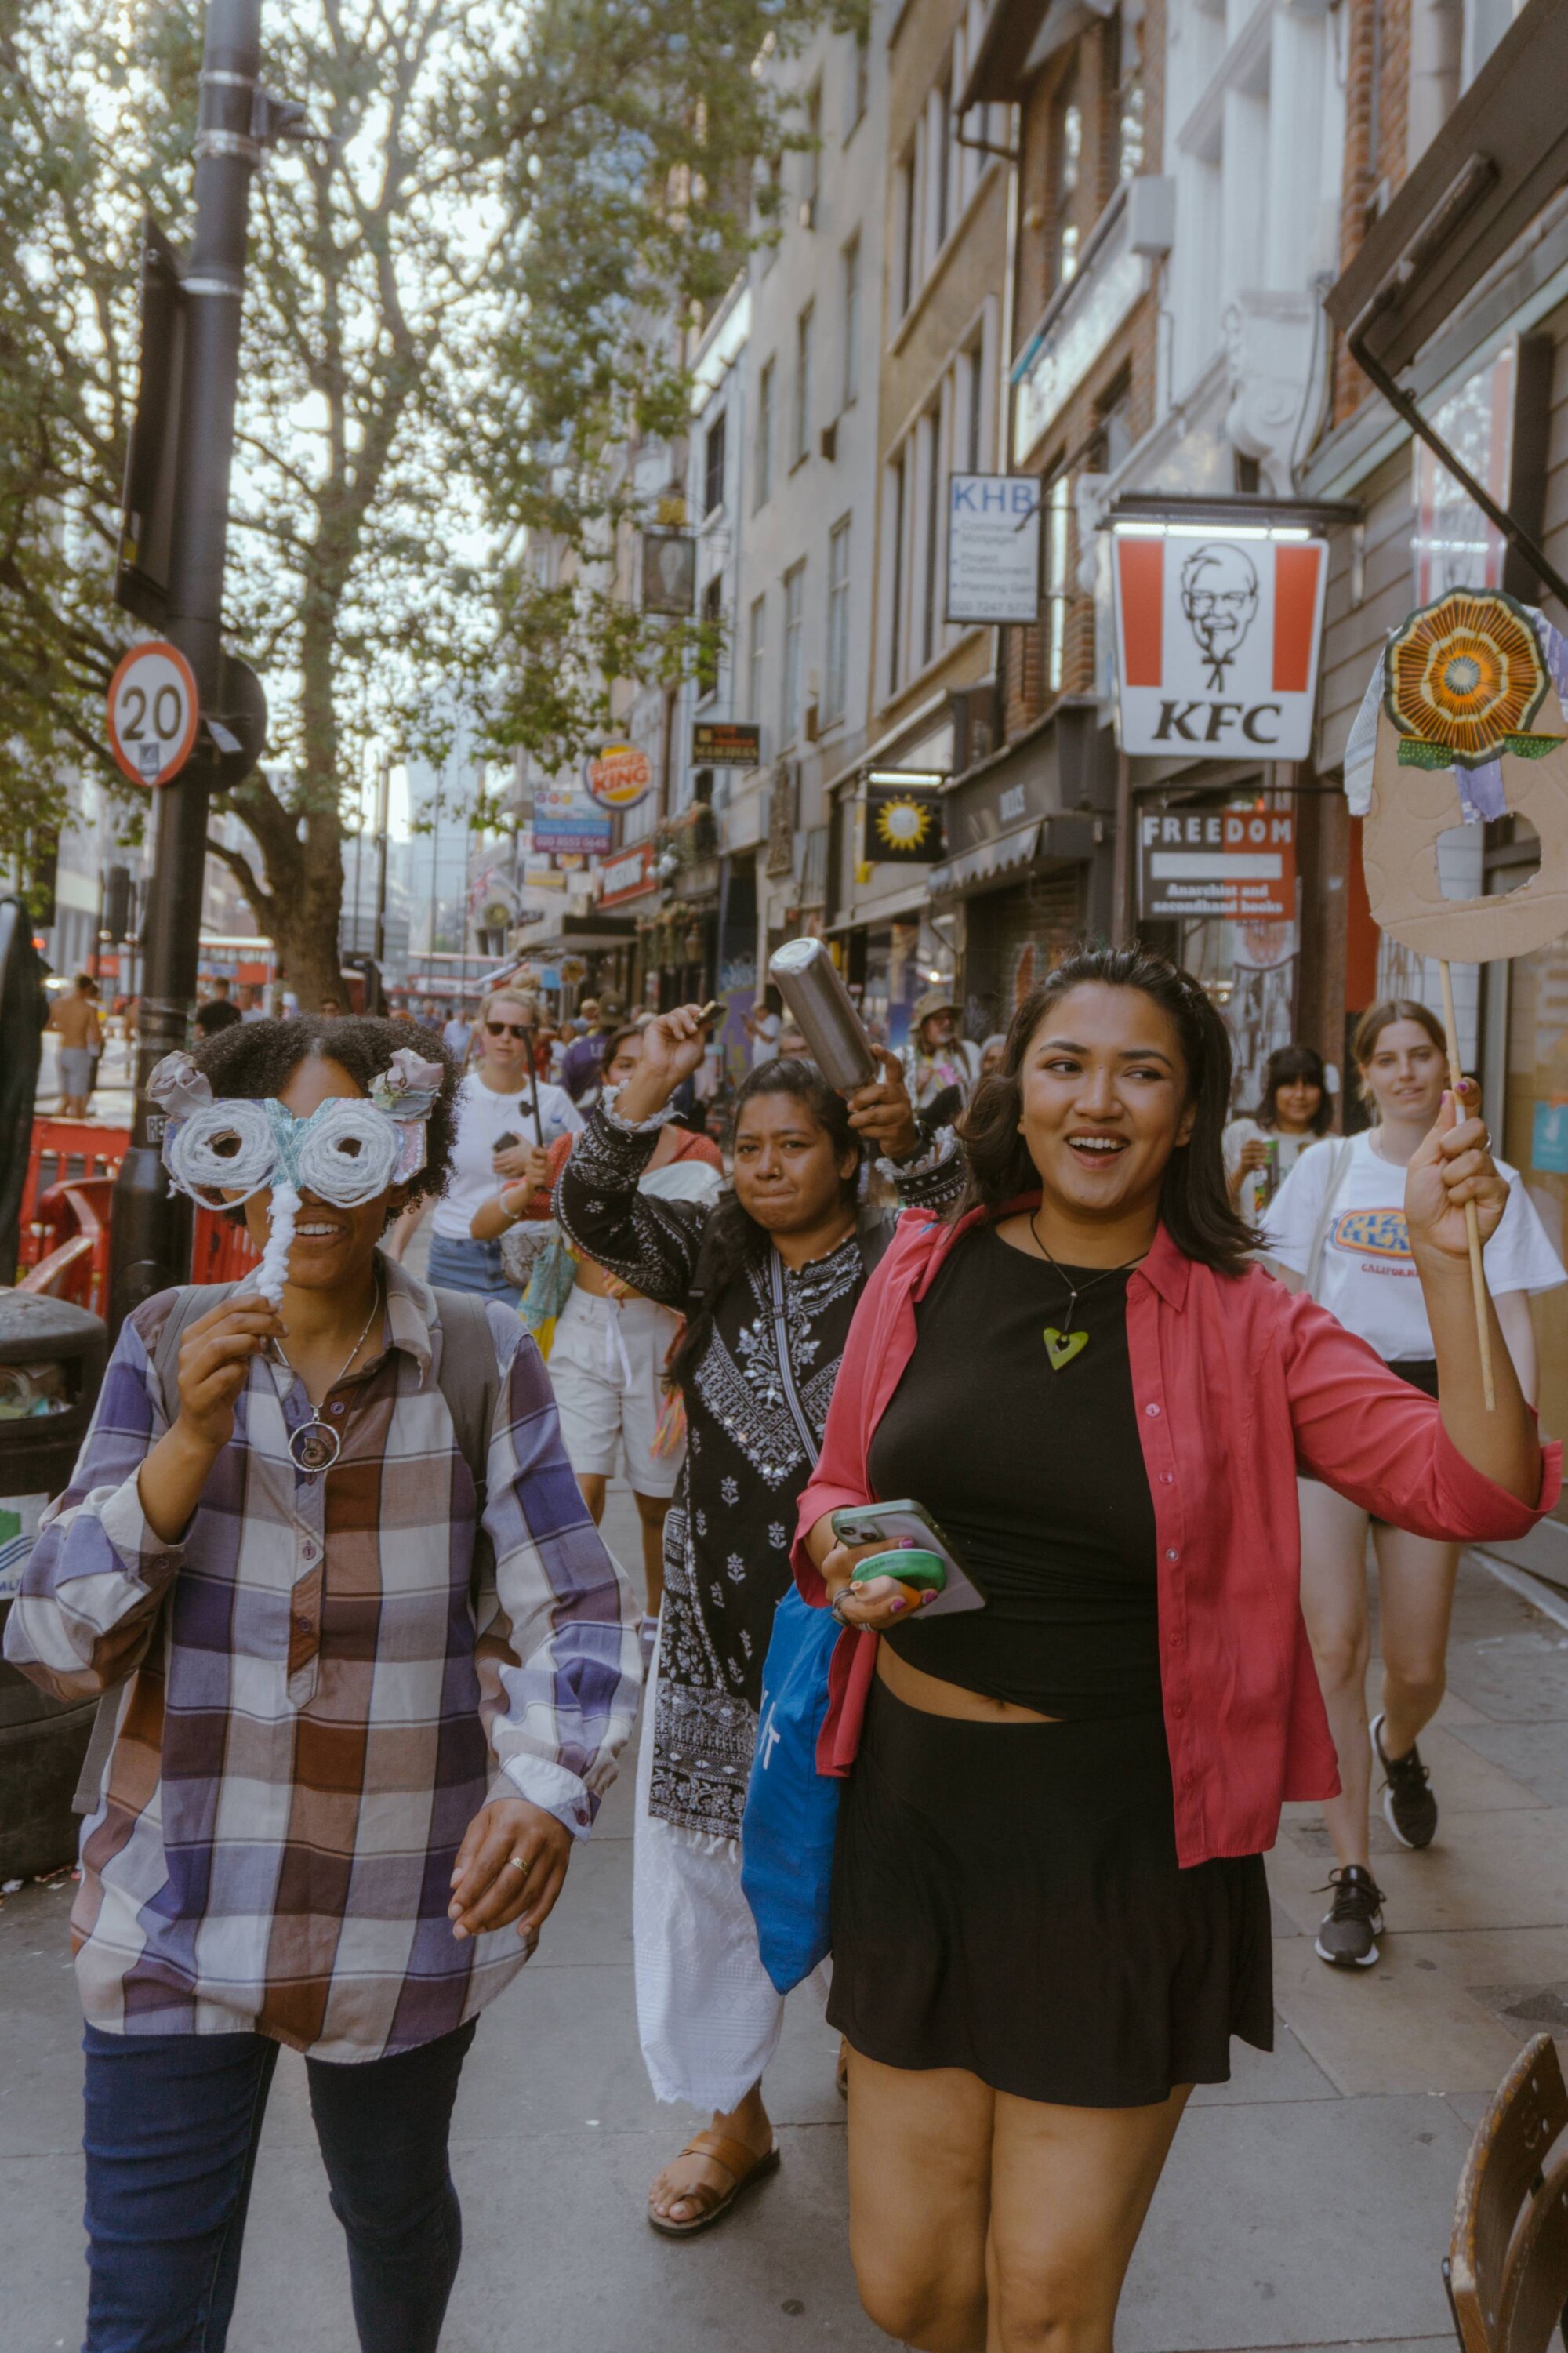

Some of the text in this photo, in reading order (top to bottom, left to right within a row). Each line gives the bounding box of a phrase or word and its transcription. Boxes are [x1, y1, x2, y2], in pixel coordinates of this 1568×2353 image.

[953, 482, 1033, 513] KHB
[961, 564, 1031, 576] Development
[122, 684, 182, 741] 20
[1151, 700, 1281, 744] KFC
[590, 753, 646, 775] BURGER
[592, 766, 649, 795] KING
[1142, 816, 1293, 847] FREEDOM
[1167, 884, 1269, 897] Anarchist and
[1152, 899, 1283, 913] secondhand books
